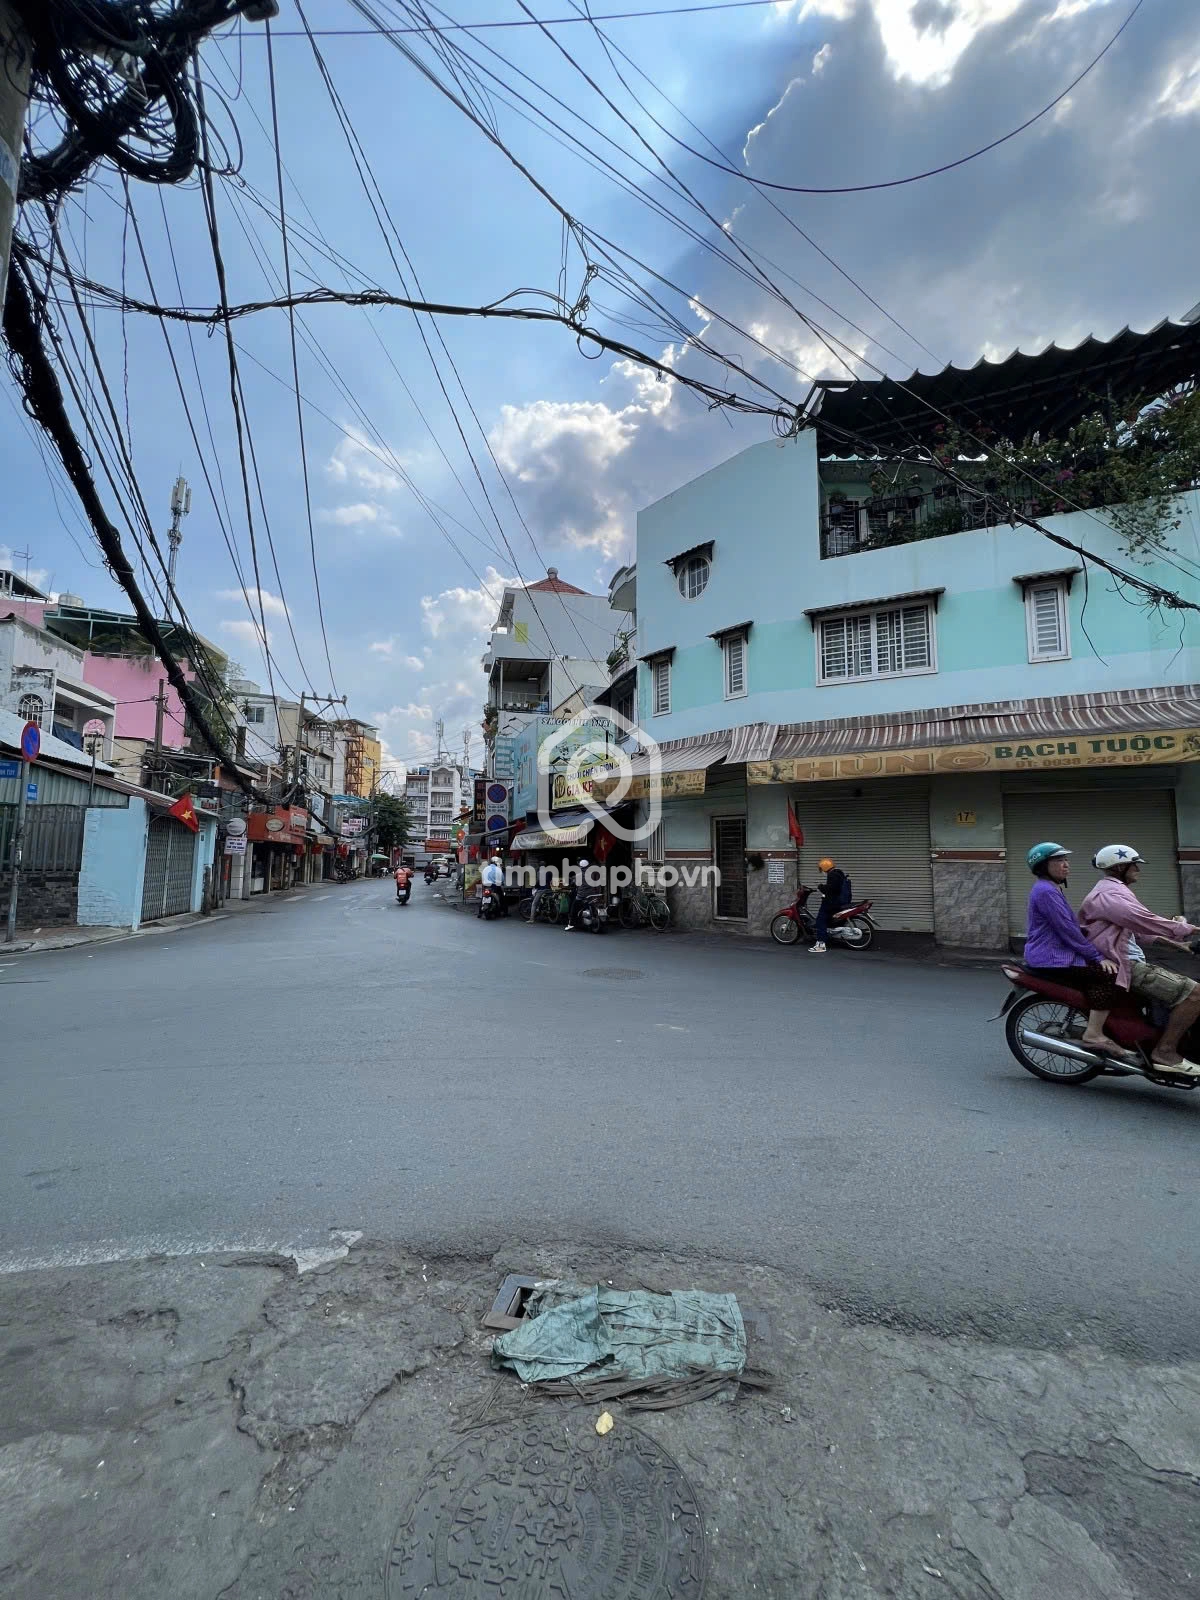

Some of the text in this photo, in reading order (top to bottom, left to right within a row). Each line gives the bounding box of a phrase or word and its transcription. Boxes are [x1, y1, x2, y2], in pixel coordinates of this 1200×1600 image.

[995, 735, 1176, 760] BẠCH TUỘC
[1088, 755, 1117, 764] 232
